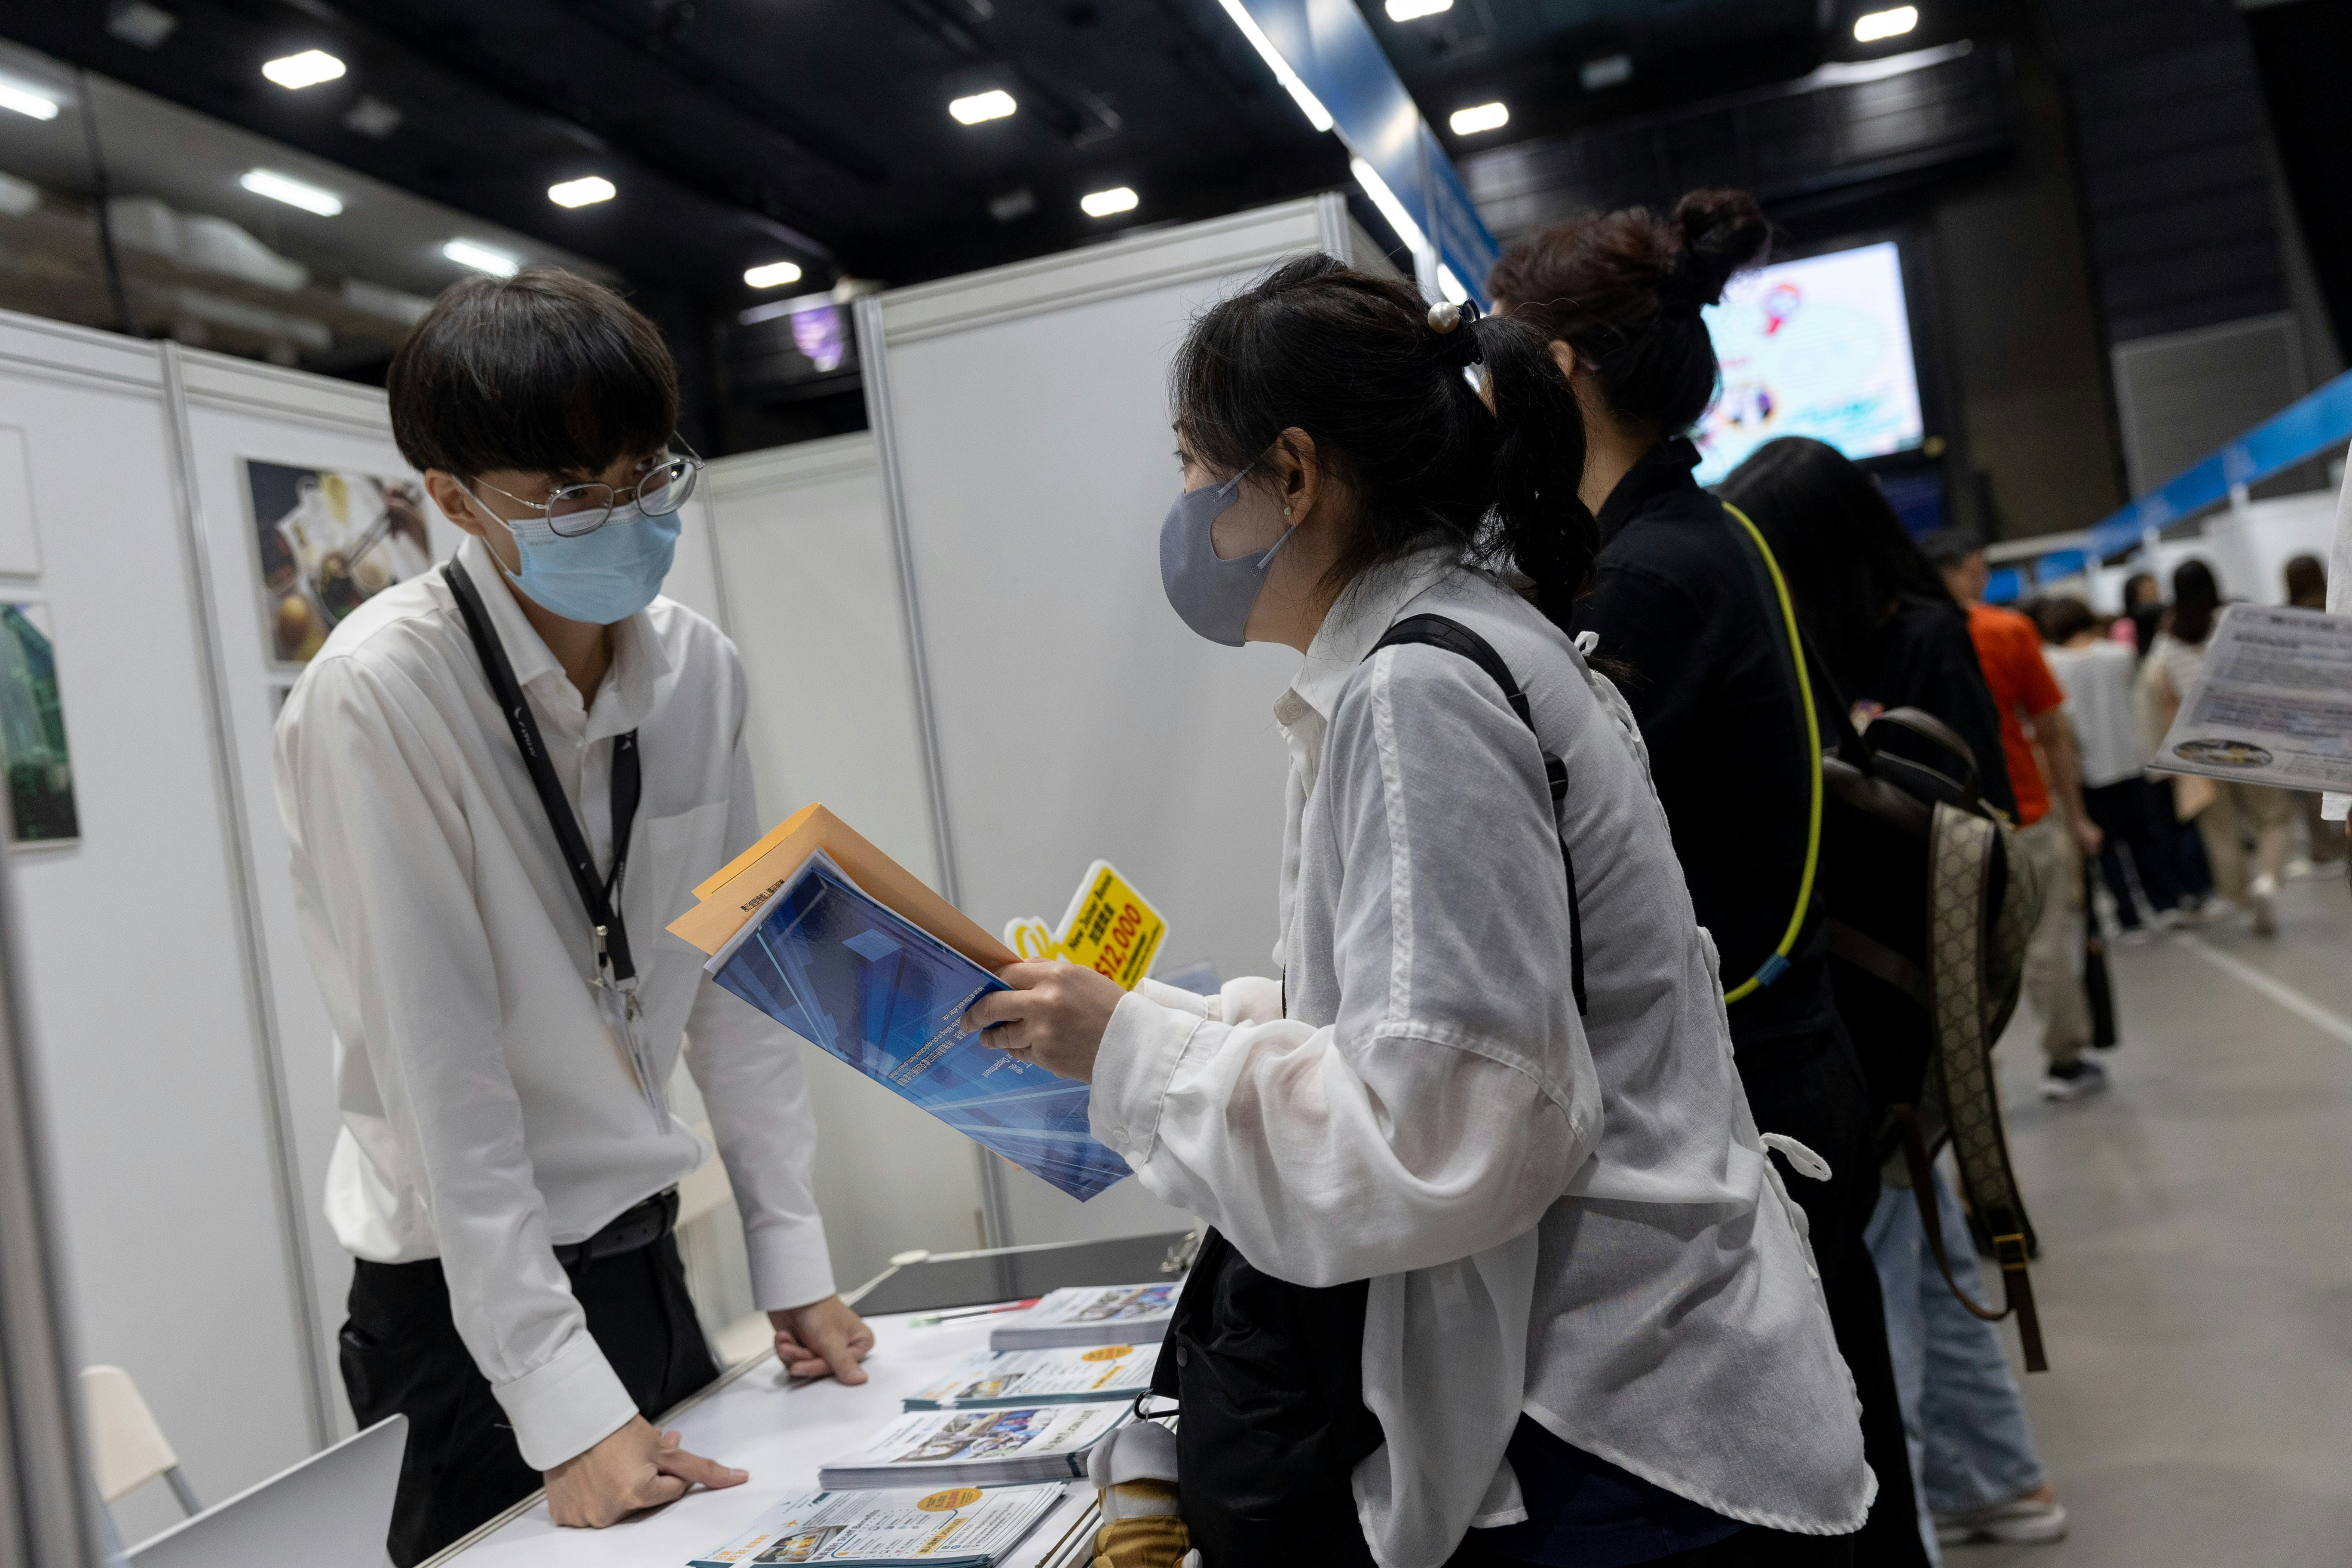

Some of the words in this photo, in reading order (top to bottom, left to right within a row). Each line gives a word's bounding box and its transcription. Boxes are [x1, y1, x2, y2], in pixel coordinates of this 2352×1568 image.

[948, 1006, 959, 1016] after
[939, 1025, 954, 1035] filling
[914, 1041, 934, 1057] application
[905, 1054, 919, 1063] form,
[896, 1060, 909, 1072] please
[981, 1057, 1011, 1078] Department
[887, 1069, 899, 1079] return
[836, 1530, 857, 1541] Staff
